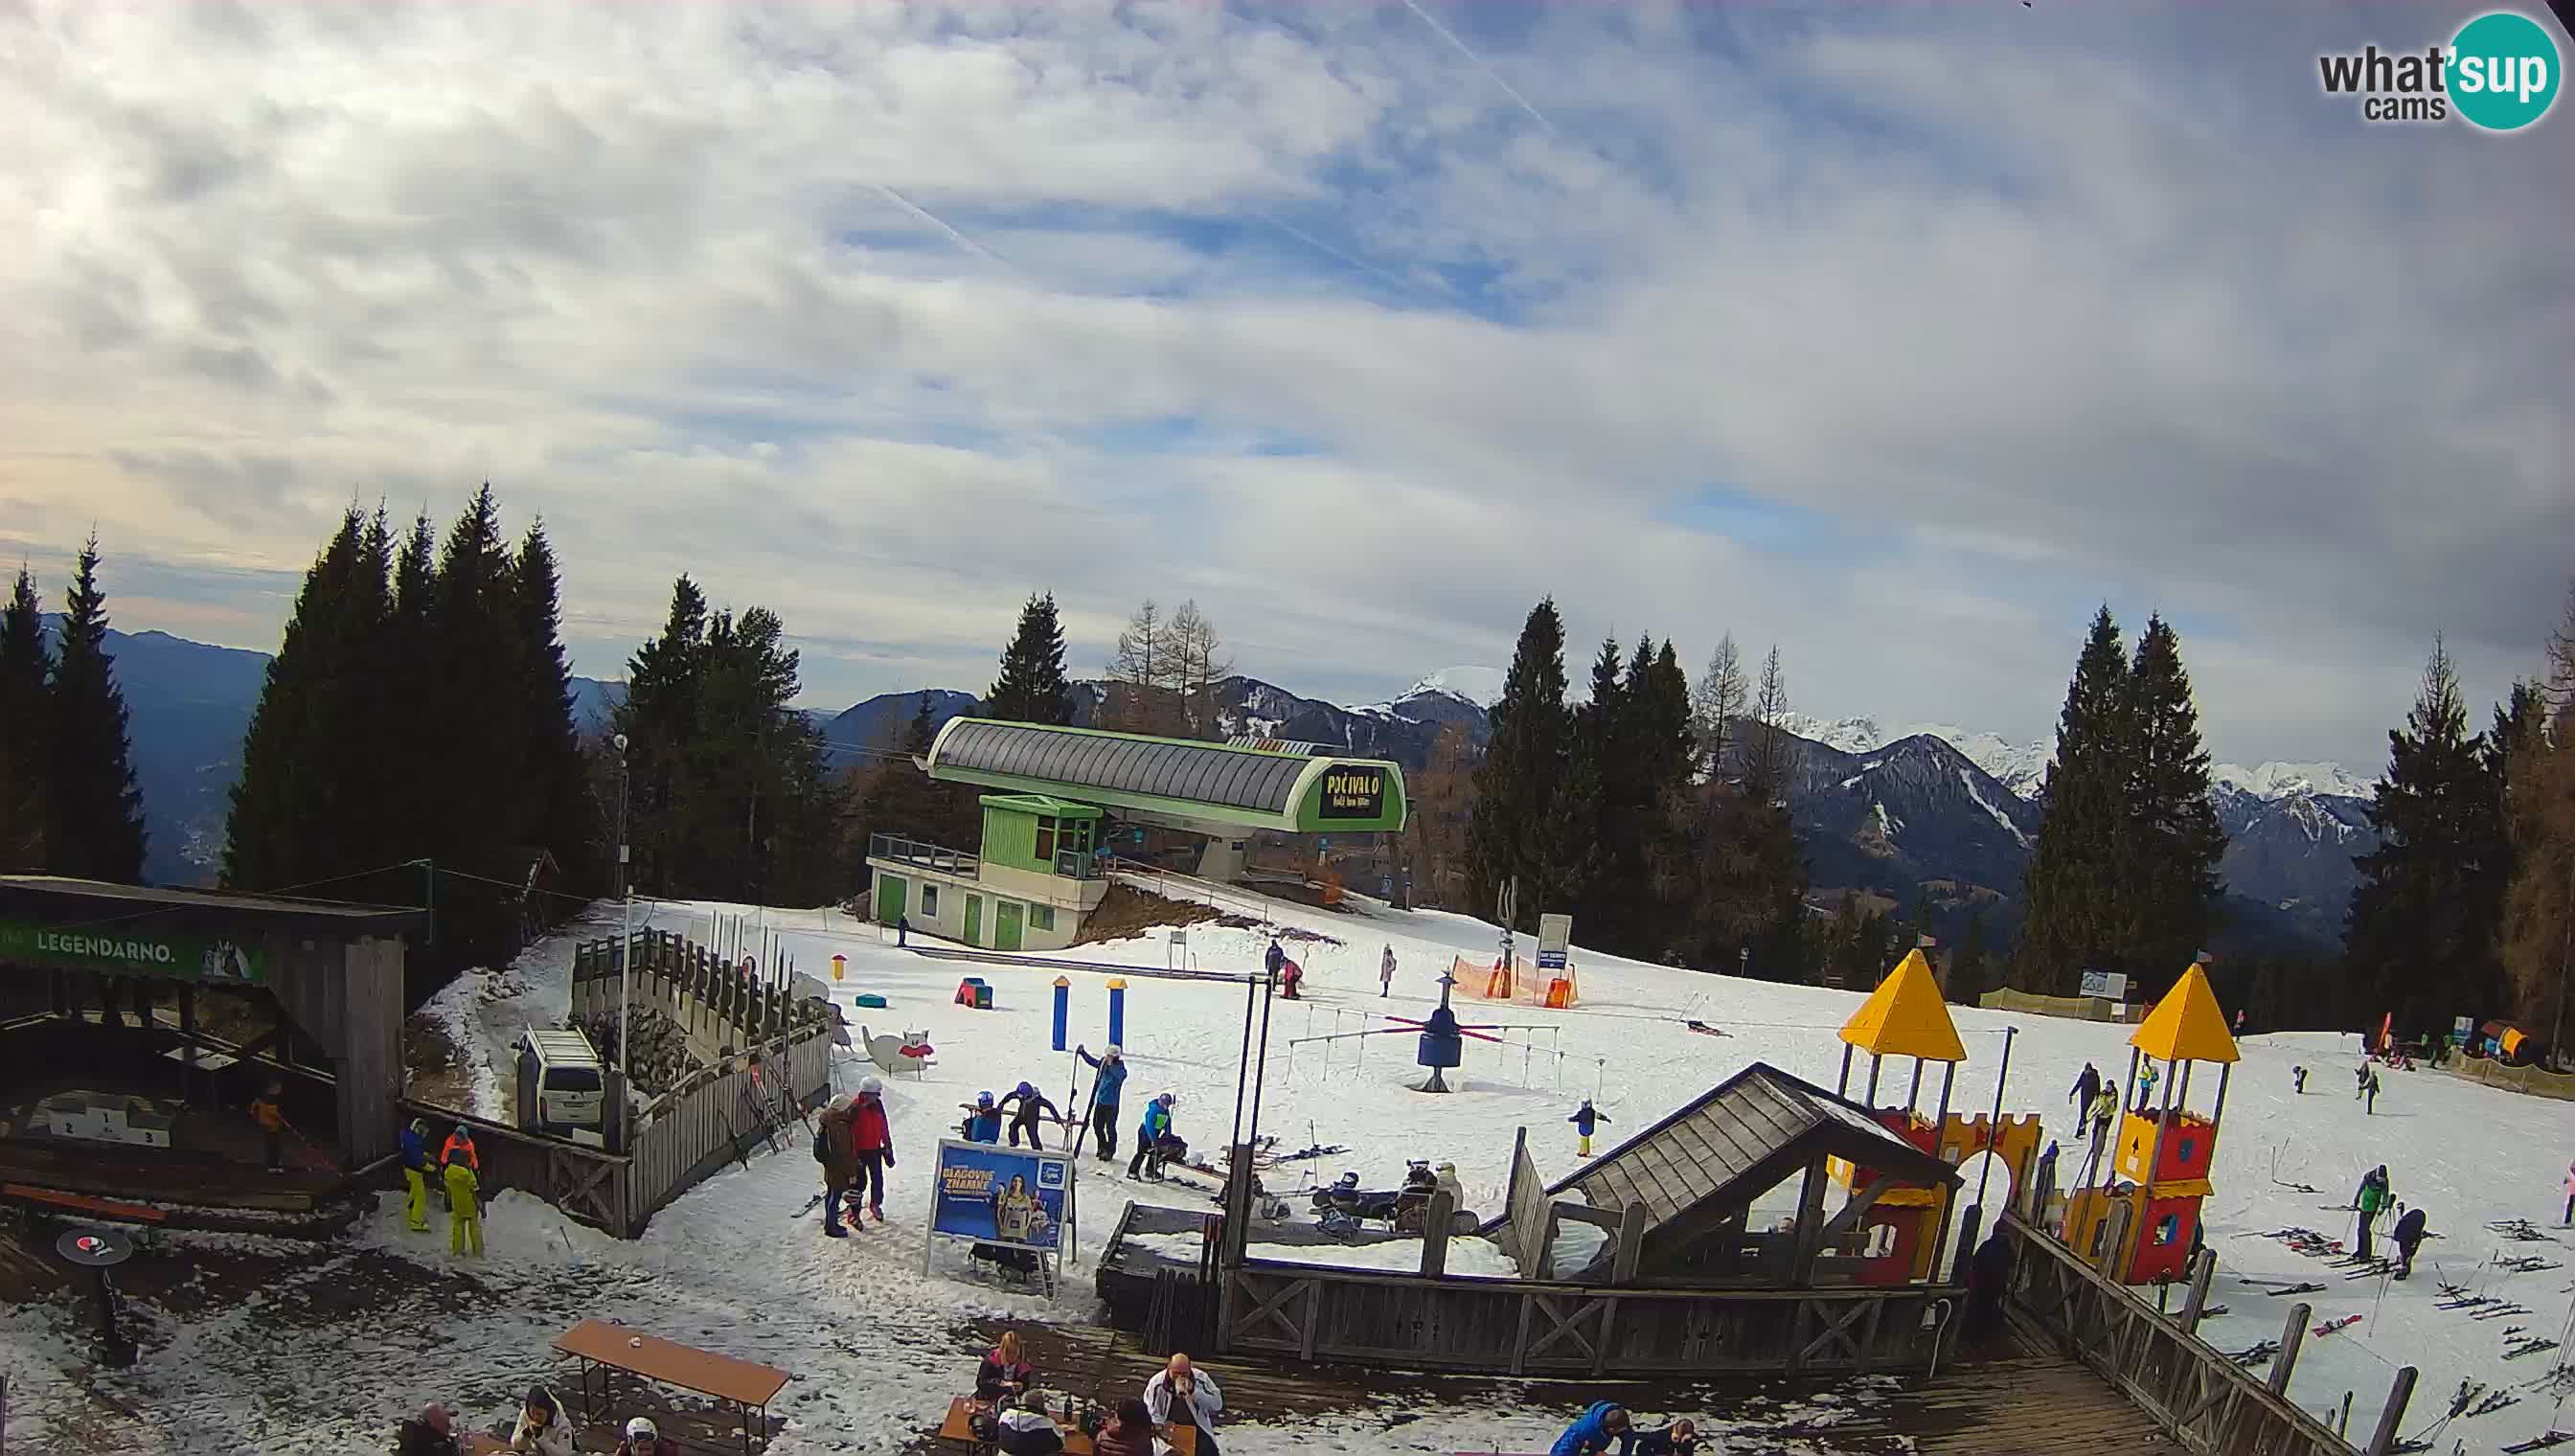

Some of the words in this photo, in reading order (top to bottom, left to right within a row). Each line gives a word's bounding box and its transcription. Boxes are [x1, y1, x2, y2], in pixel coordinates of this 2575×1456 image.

[36, 931, 176, 963] LEGENDARNO.
[65, 1122, 74, 1134] 2
[145, 1131, 154, 1144] 3
